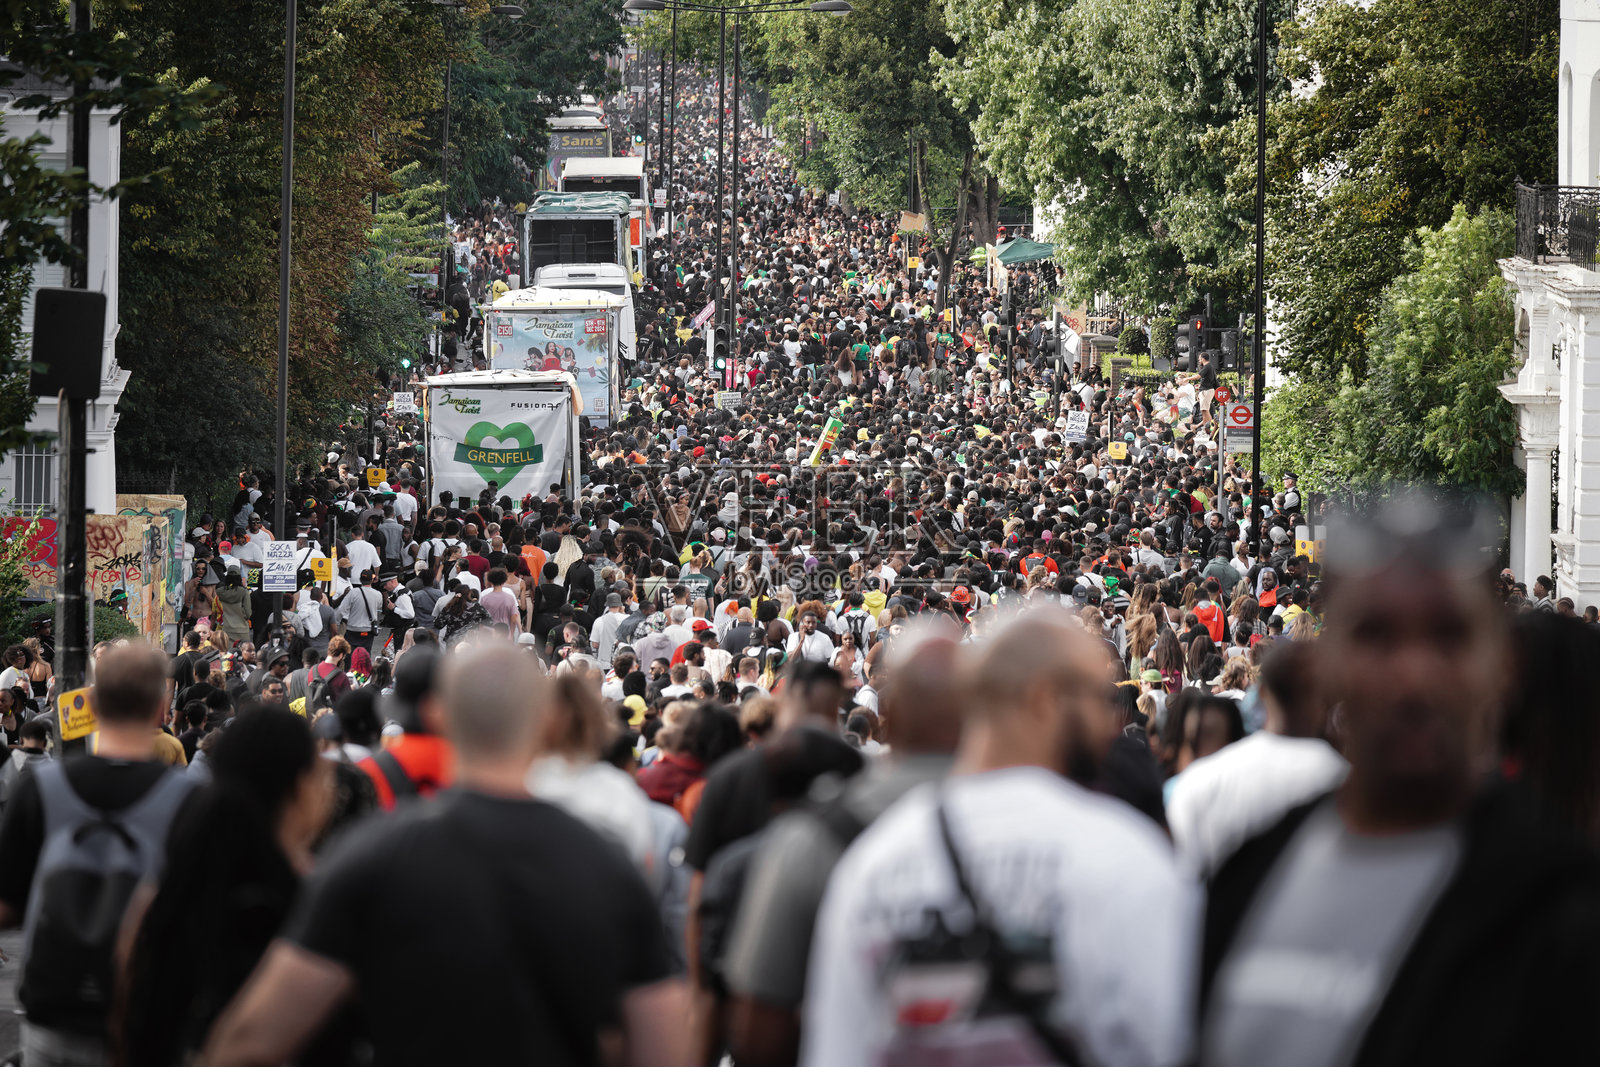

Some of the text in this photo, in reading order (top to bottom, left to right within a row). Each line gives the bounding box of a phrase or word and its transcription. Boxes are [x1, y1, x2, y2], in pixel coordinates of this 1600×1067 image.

[561, 135, 603, 147] Sam's
[524, 317, 574, 331] Jamaican
[543, 328, 574, 339] Twist
[438, 393, 481, 406] Jamaican
[1217, 391, 1228, 399] PF
[454, 403, 481, 414] Twist
[467, 449, 535, 464] GRENFELL
[269, 543, 291, 551] SOCA
[265, 562, 294, 573] ZANTE
